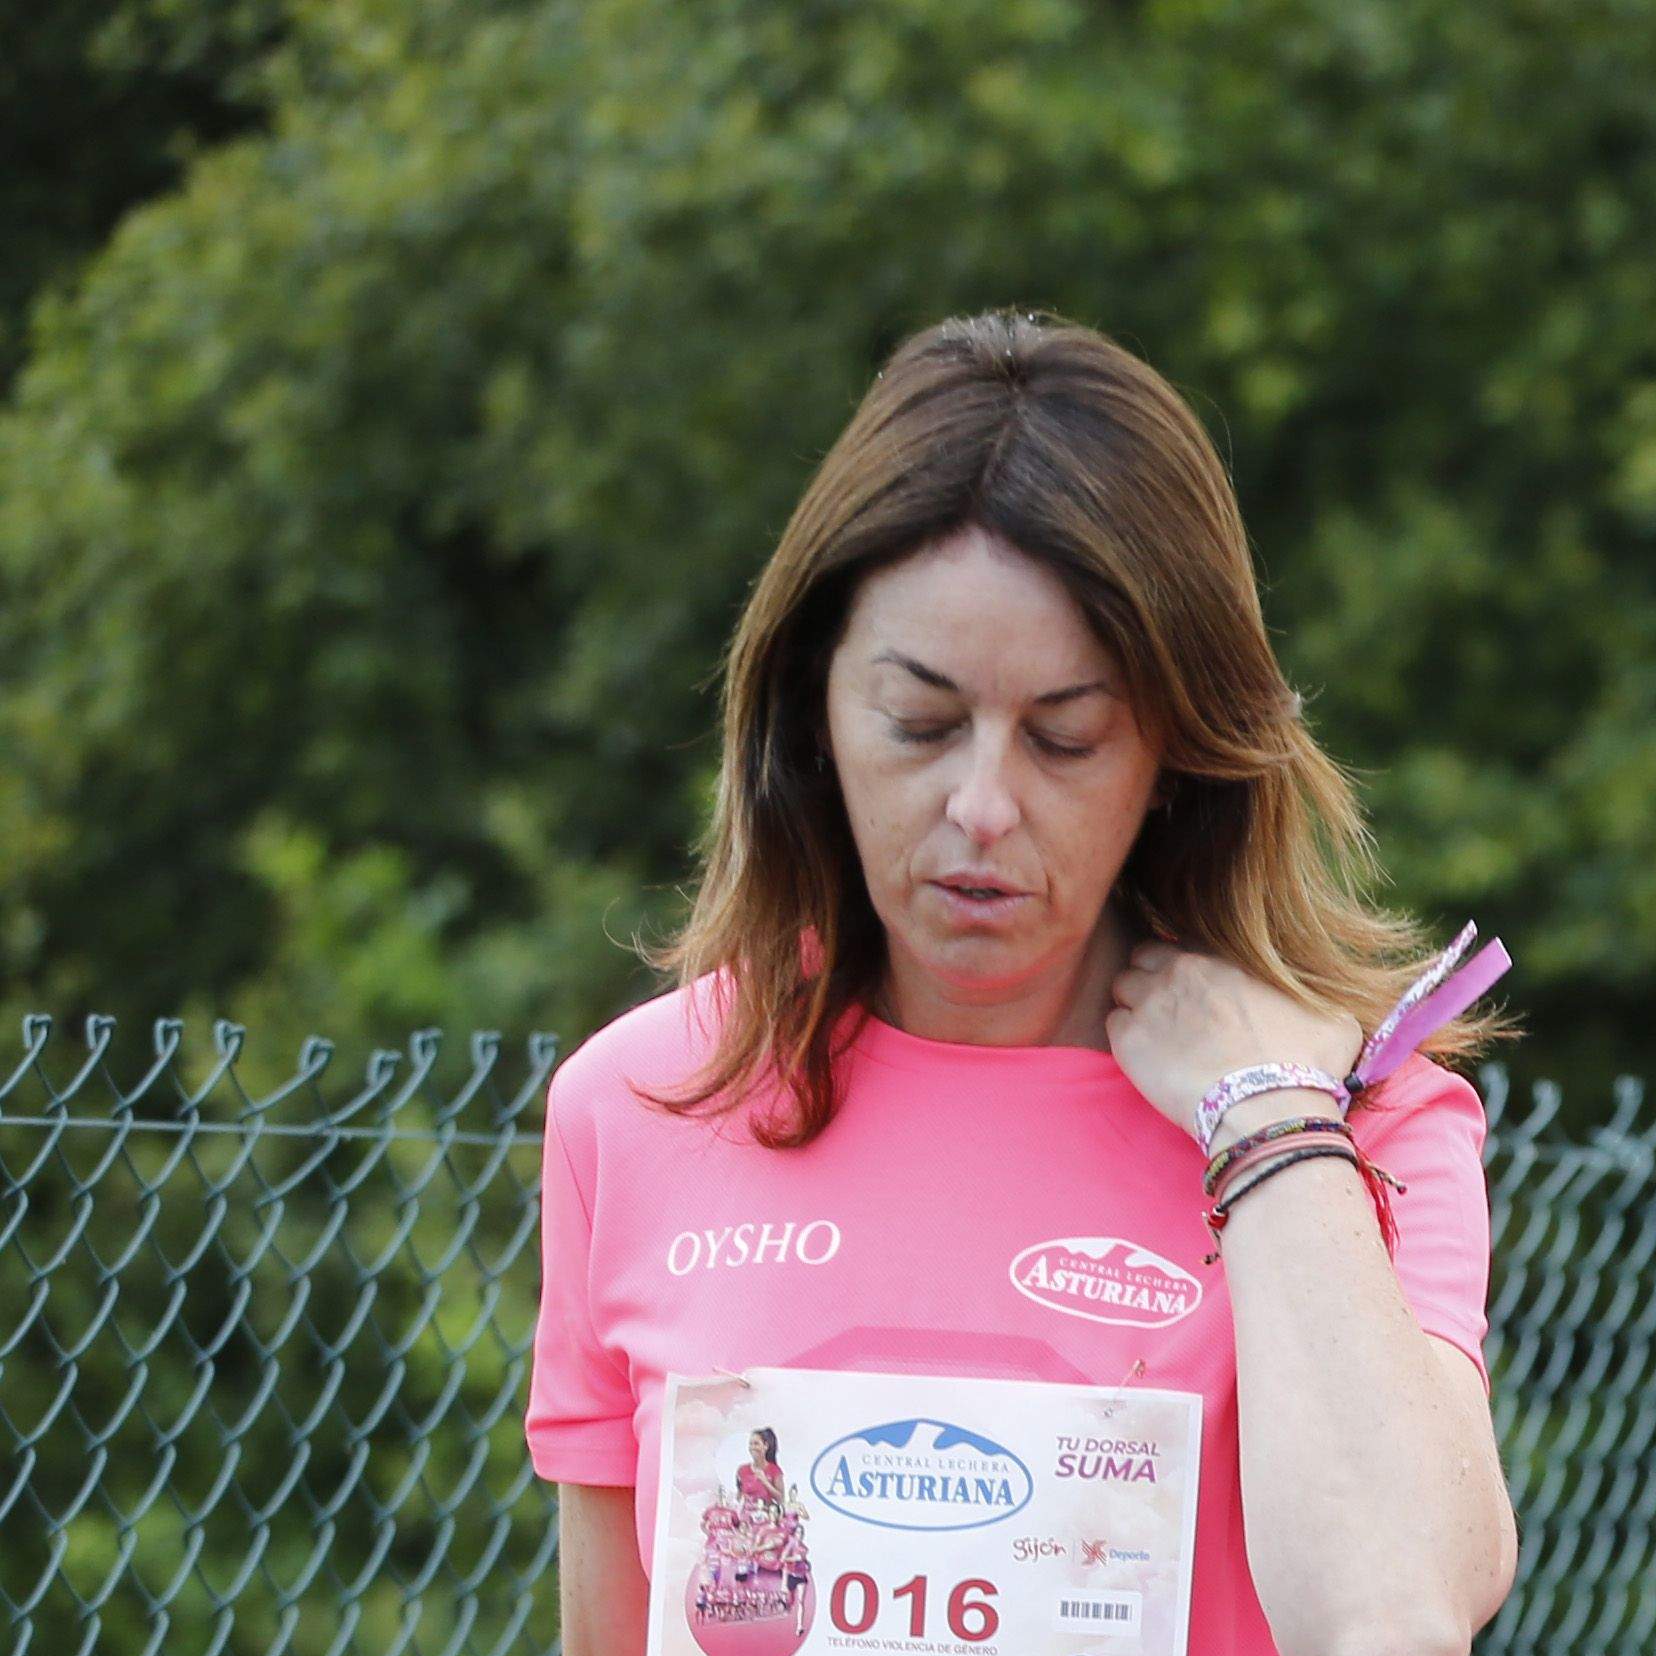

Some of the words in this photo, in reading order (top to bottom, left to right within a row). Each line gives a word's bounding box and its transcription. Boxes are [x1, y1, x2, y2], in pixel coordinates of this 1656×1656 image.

[667, 1219, 841, 1275] OYSHO
[1022, 1254, 1186, 1314] ASTURIANA
[1060, 1256, 1120, 1279] CENTRAL
[1126, 1271, 1188, 1292] LECHERA
[862, 1453, 931, 1468] CENTRAL
[938, 1458, 1010, 1473] LECHERA
[1056, 1436, 1080, 1450] TU
[1084, 1438, 1160, 1457] DORSAL
[827, 1455, 1014, 1506] ASTURIANA
[1055, 1454, 1157, 1483] SUMA
[830, 1571, 999, 1641] 016
[882, 1640, 934, 1653] VIOLENCIA
[937, 1644, 951, 1654] DE
